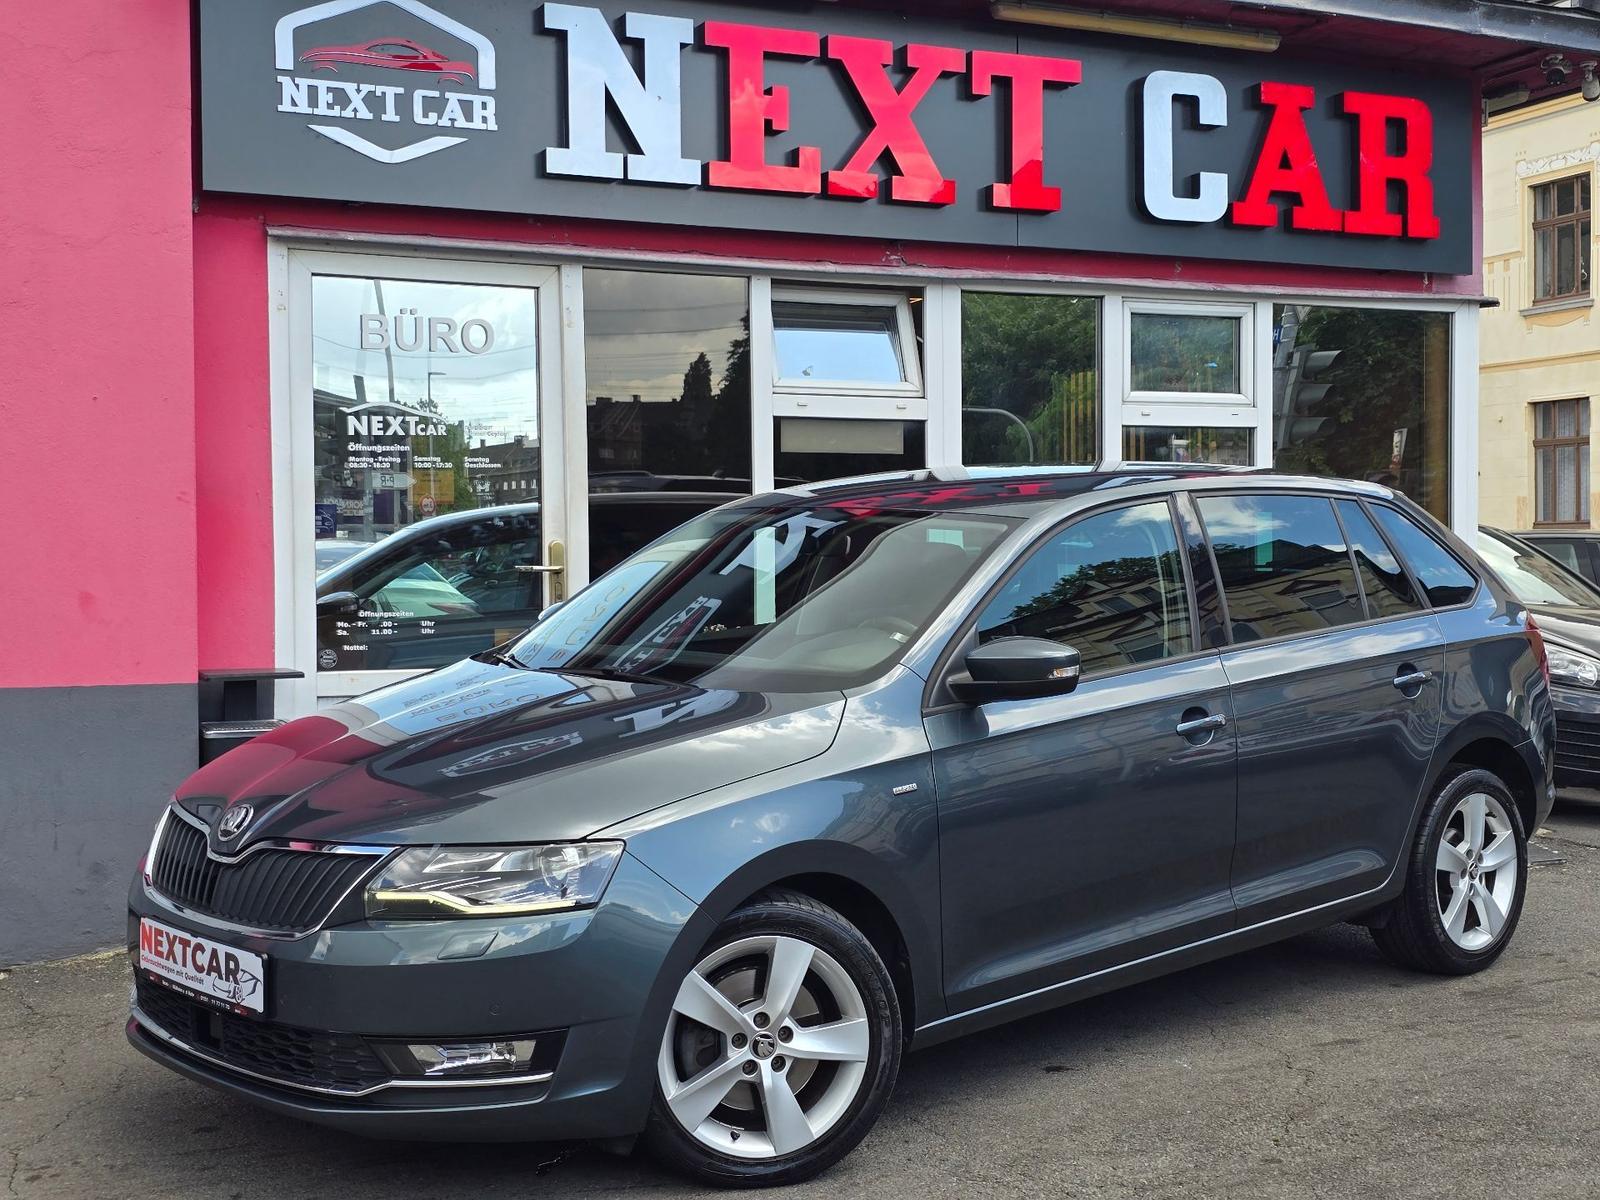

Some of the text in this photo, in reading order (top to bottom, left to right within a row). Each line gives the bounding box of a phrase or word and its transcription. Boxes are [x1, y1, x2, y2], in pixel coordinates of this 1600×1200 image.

[276, 75, 498, 131] NEXT CAR
[542, 2, 1441, 240] NEXT CAR
[359, 307, 495, 355] BÜRO
[348, 441, 410, 453] Öffnungszeiten
[358, 610, 414, 618] Öffnungszeiten
[141, 922, 240, 985] NEXTCAR
[175, 967, 184, 979] mit
[184, 971, 205, 986] Qualität
